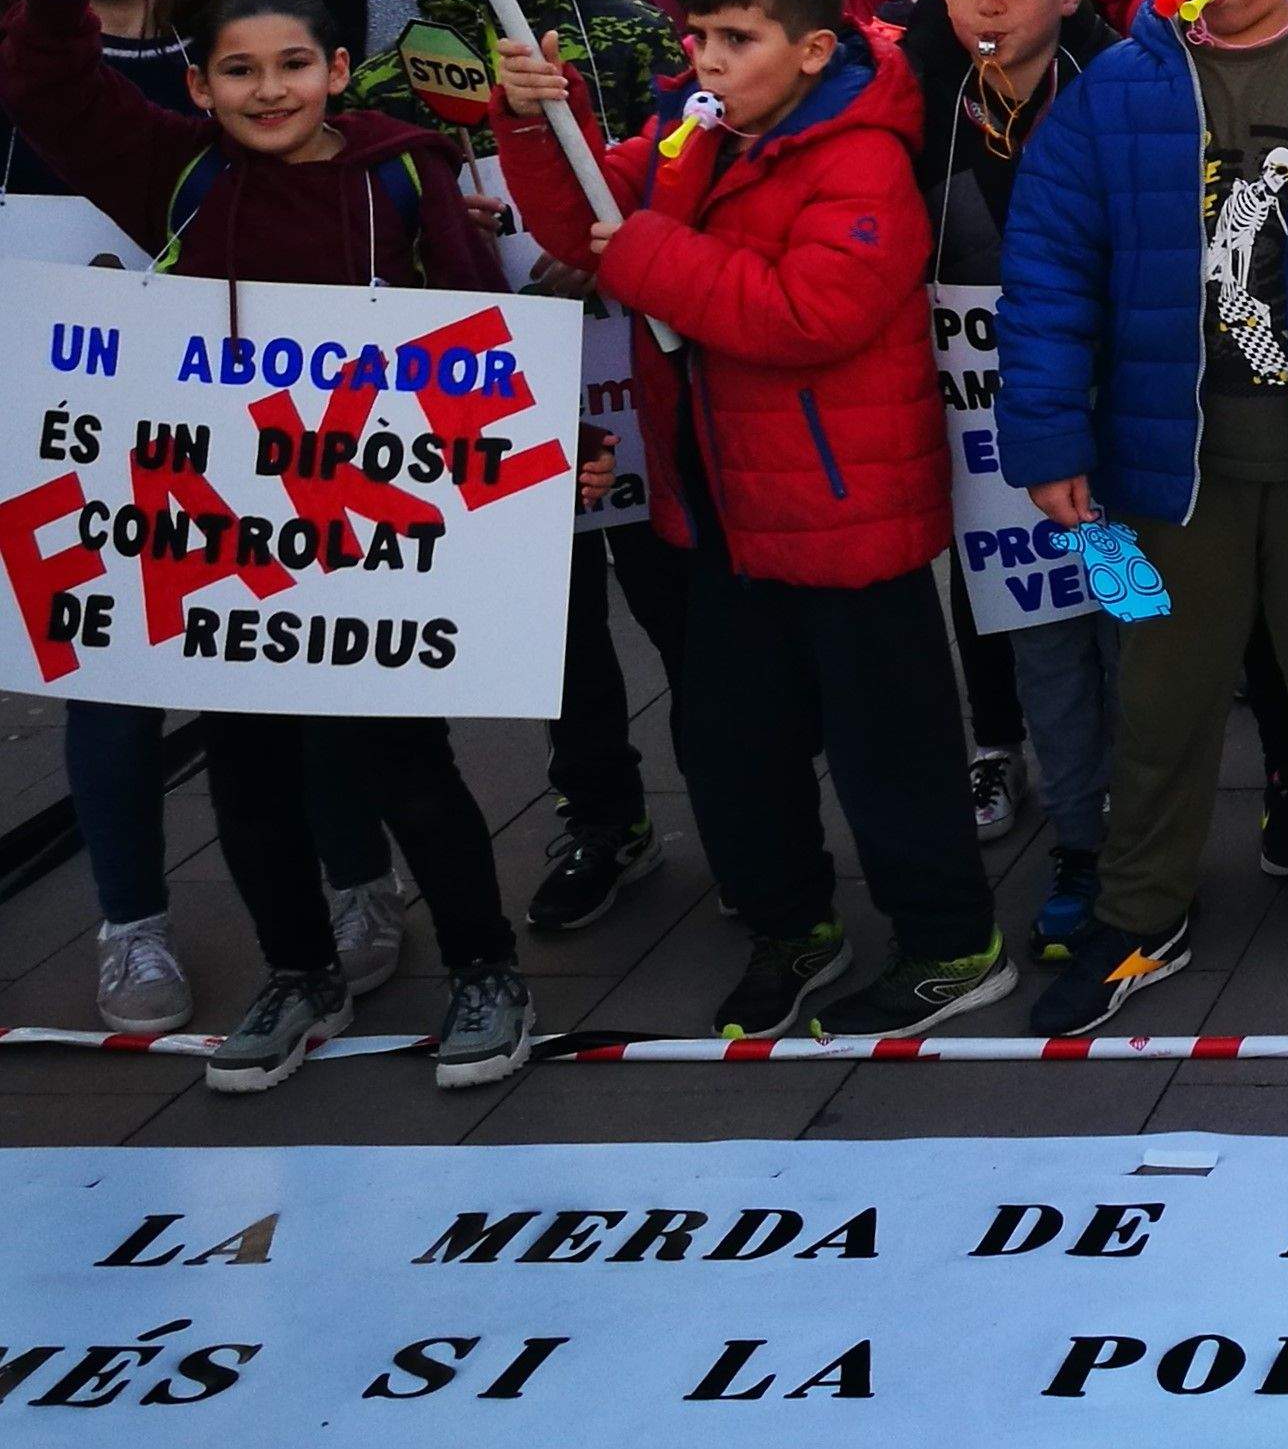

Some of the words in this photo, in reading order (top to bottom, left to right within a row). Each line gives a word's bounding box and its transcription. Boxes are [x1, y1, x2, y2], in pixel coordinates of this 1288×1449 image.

[409, 56, 486, 93] STOP
[50, 323, 120, 377] UN
[177, 335, 518, 398] ABOCADOR
[40, 400, 102, 466] ÉS
[135, 419, 211, 474] UN
[255, 418, 513, 486] DIPÒSIT
[79, 500, 447, 573] CONTROLAT
[48, 593, 115, 648] DE
[183, 607, 459, 670] RESIDUS
[93, 1212, 280, 1267] LA
[411, 1206, 879, 1267] MERDA
[968, 1202, 1166, 1258] DE
[361, 1335, 572, 1400] SI
[683, 1338, 876, 1404] LA
